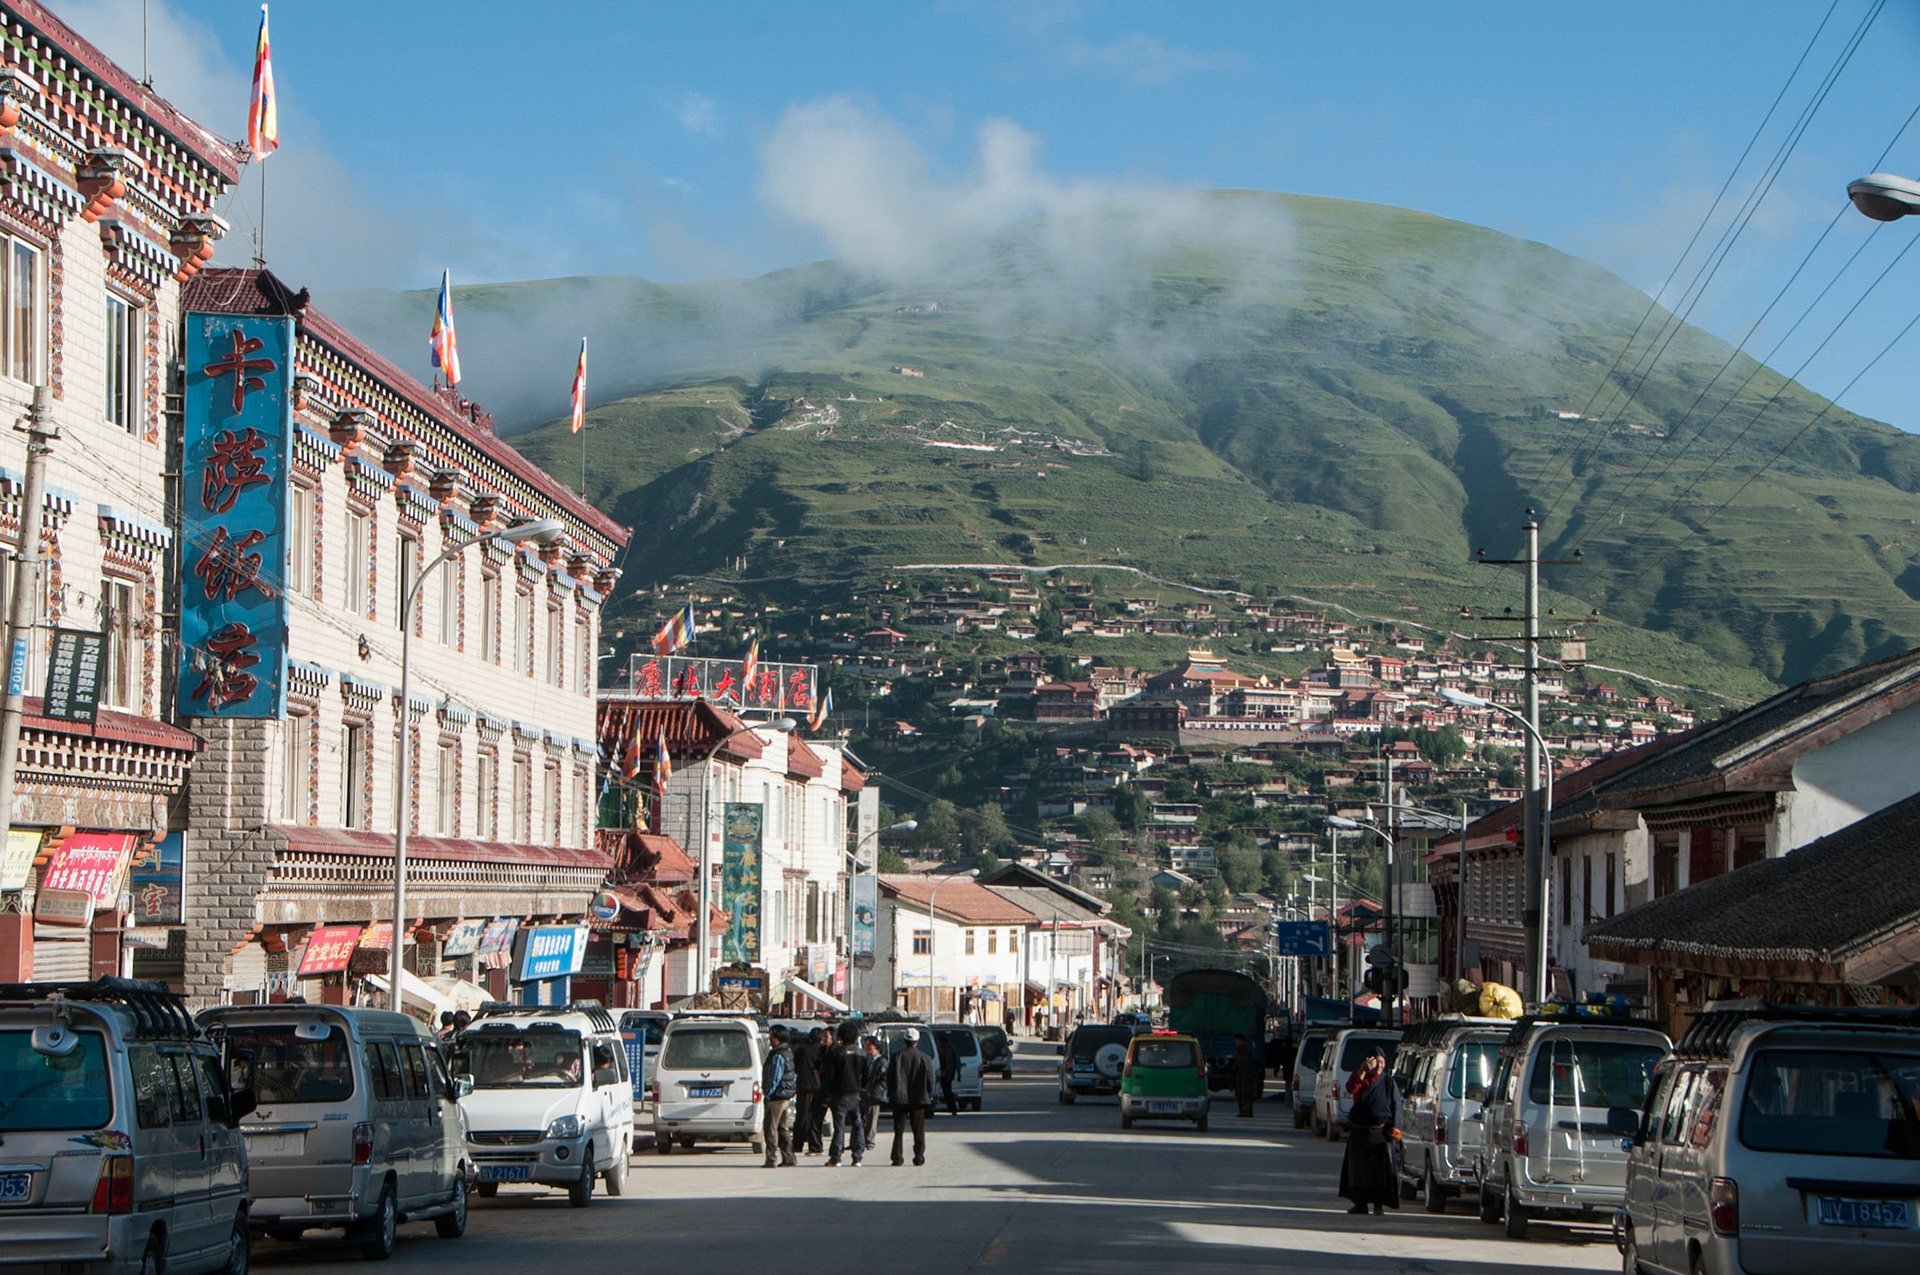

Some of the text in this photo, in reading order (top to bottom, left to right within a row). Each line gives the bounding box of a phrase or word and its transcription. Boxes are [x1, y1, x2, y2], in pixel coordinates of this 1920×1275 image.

[193, 328, 277, 703] 卡萨饭店
[635, 658, 810, 707] 康北大酒店
[305, 939, 354, 963] 金堂饭店
